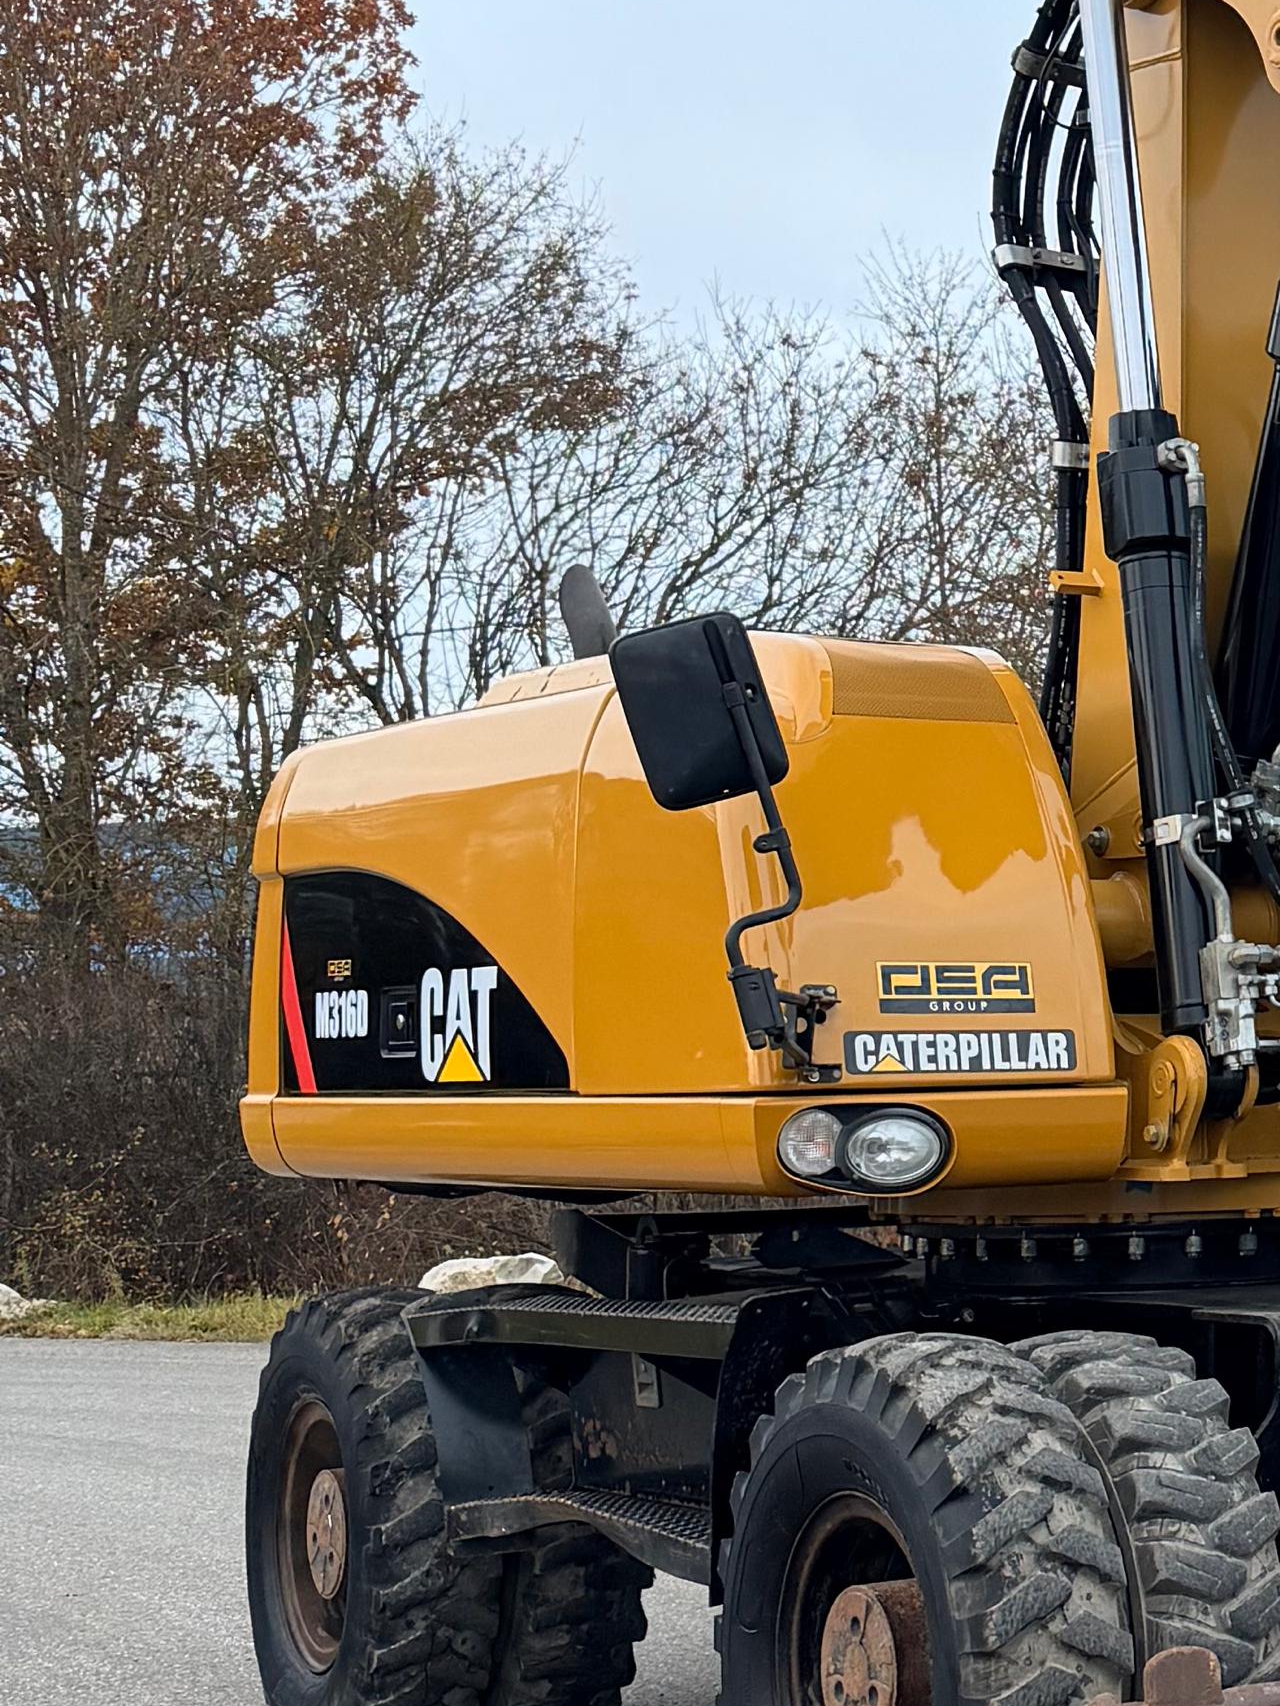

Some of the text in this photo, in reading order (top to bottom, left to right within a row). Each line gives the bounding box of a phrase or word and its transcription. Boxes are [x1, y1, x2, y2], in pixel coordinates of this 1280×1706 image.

[315, 990, 369, 1039] M316D
[420, 966, 498, 1083] CAT
[929, 1000, 988, 1012] GROUP
[854, 1032, 1069, 1073] CATERPILLAR
